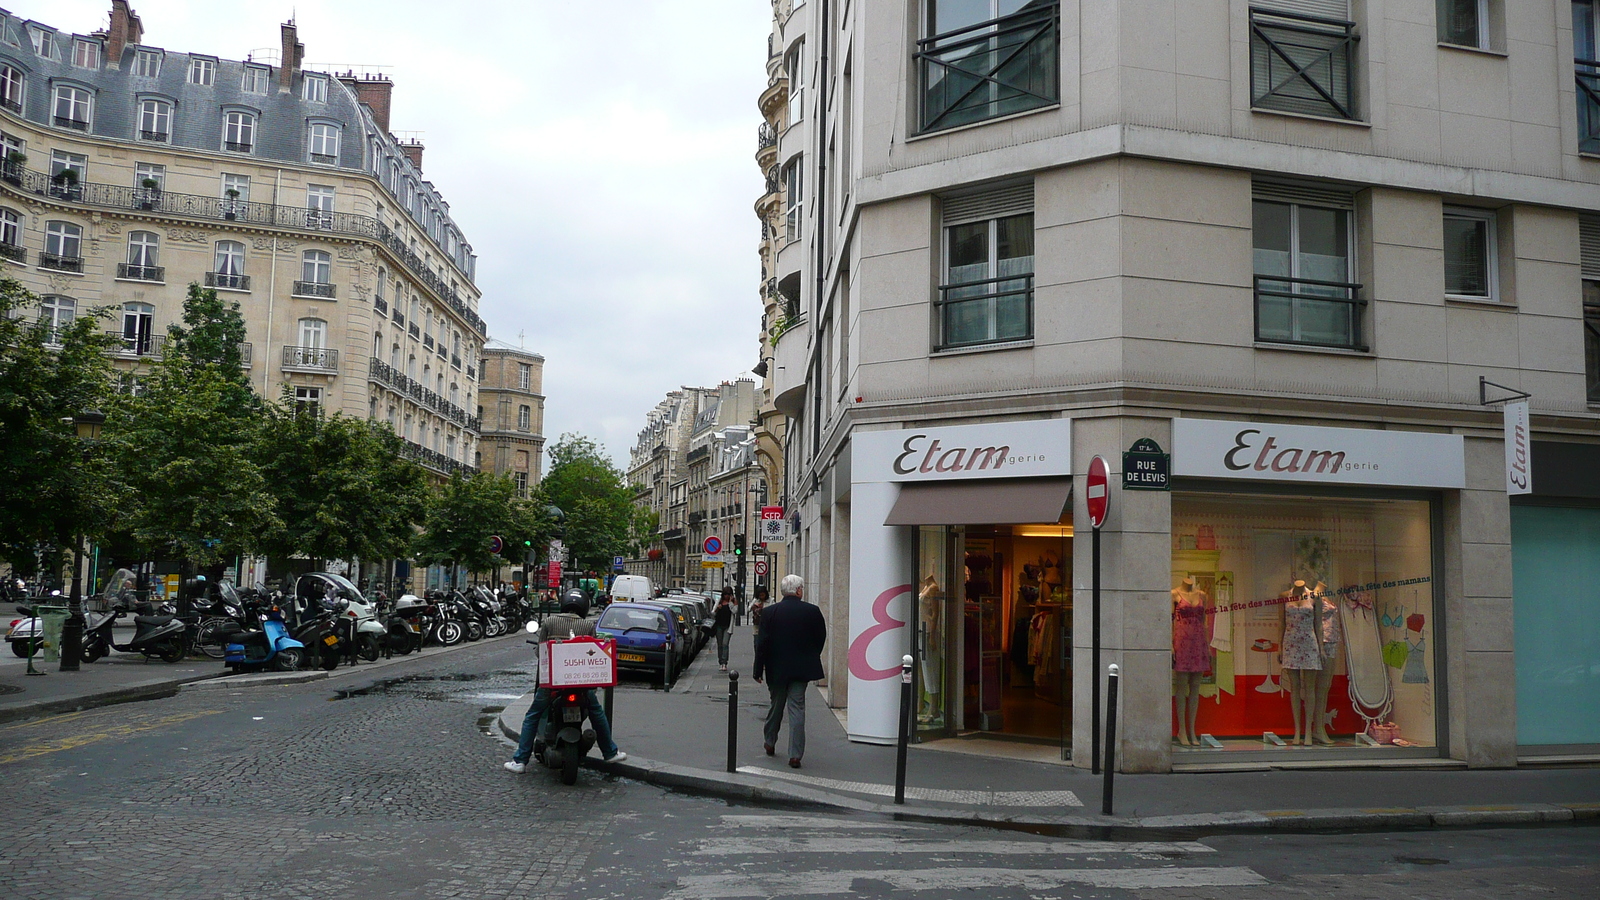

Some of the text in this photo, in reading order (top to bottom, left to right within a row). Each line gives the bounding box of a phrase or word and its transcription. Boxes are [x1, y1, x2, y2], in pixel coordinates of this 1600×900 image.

[893, 434, 1010, 475] Etam
[1223, 429, 1346, 474] Etam
[1510, 425, 1527, 490] Etam
[1136, 460, 1156, 470] RUE
[1127, 472, 1166, 483] DE LEVIS
[1300, 593, 1308, 601] le
[1365, 582, 1382, 591] fête
[1382, 580, 1396, 589] des
[1397, 576, 1431, 586] mamans
[1219, 605, 1229, 613] la
[1230, 602, 1247, 612] fête
[1247, 600, 1263, 609] des
[1264, 595, 1300, 606] mamans
[563, 658, 586, 667] SUSHI
[587, 657, 608, 666] WEST
